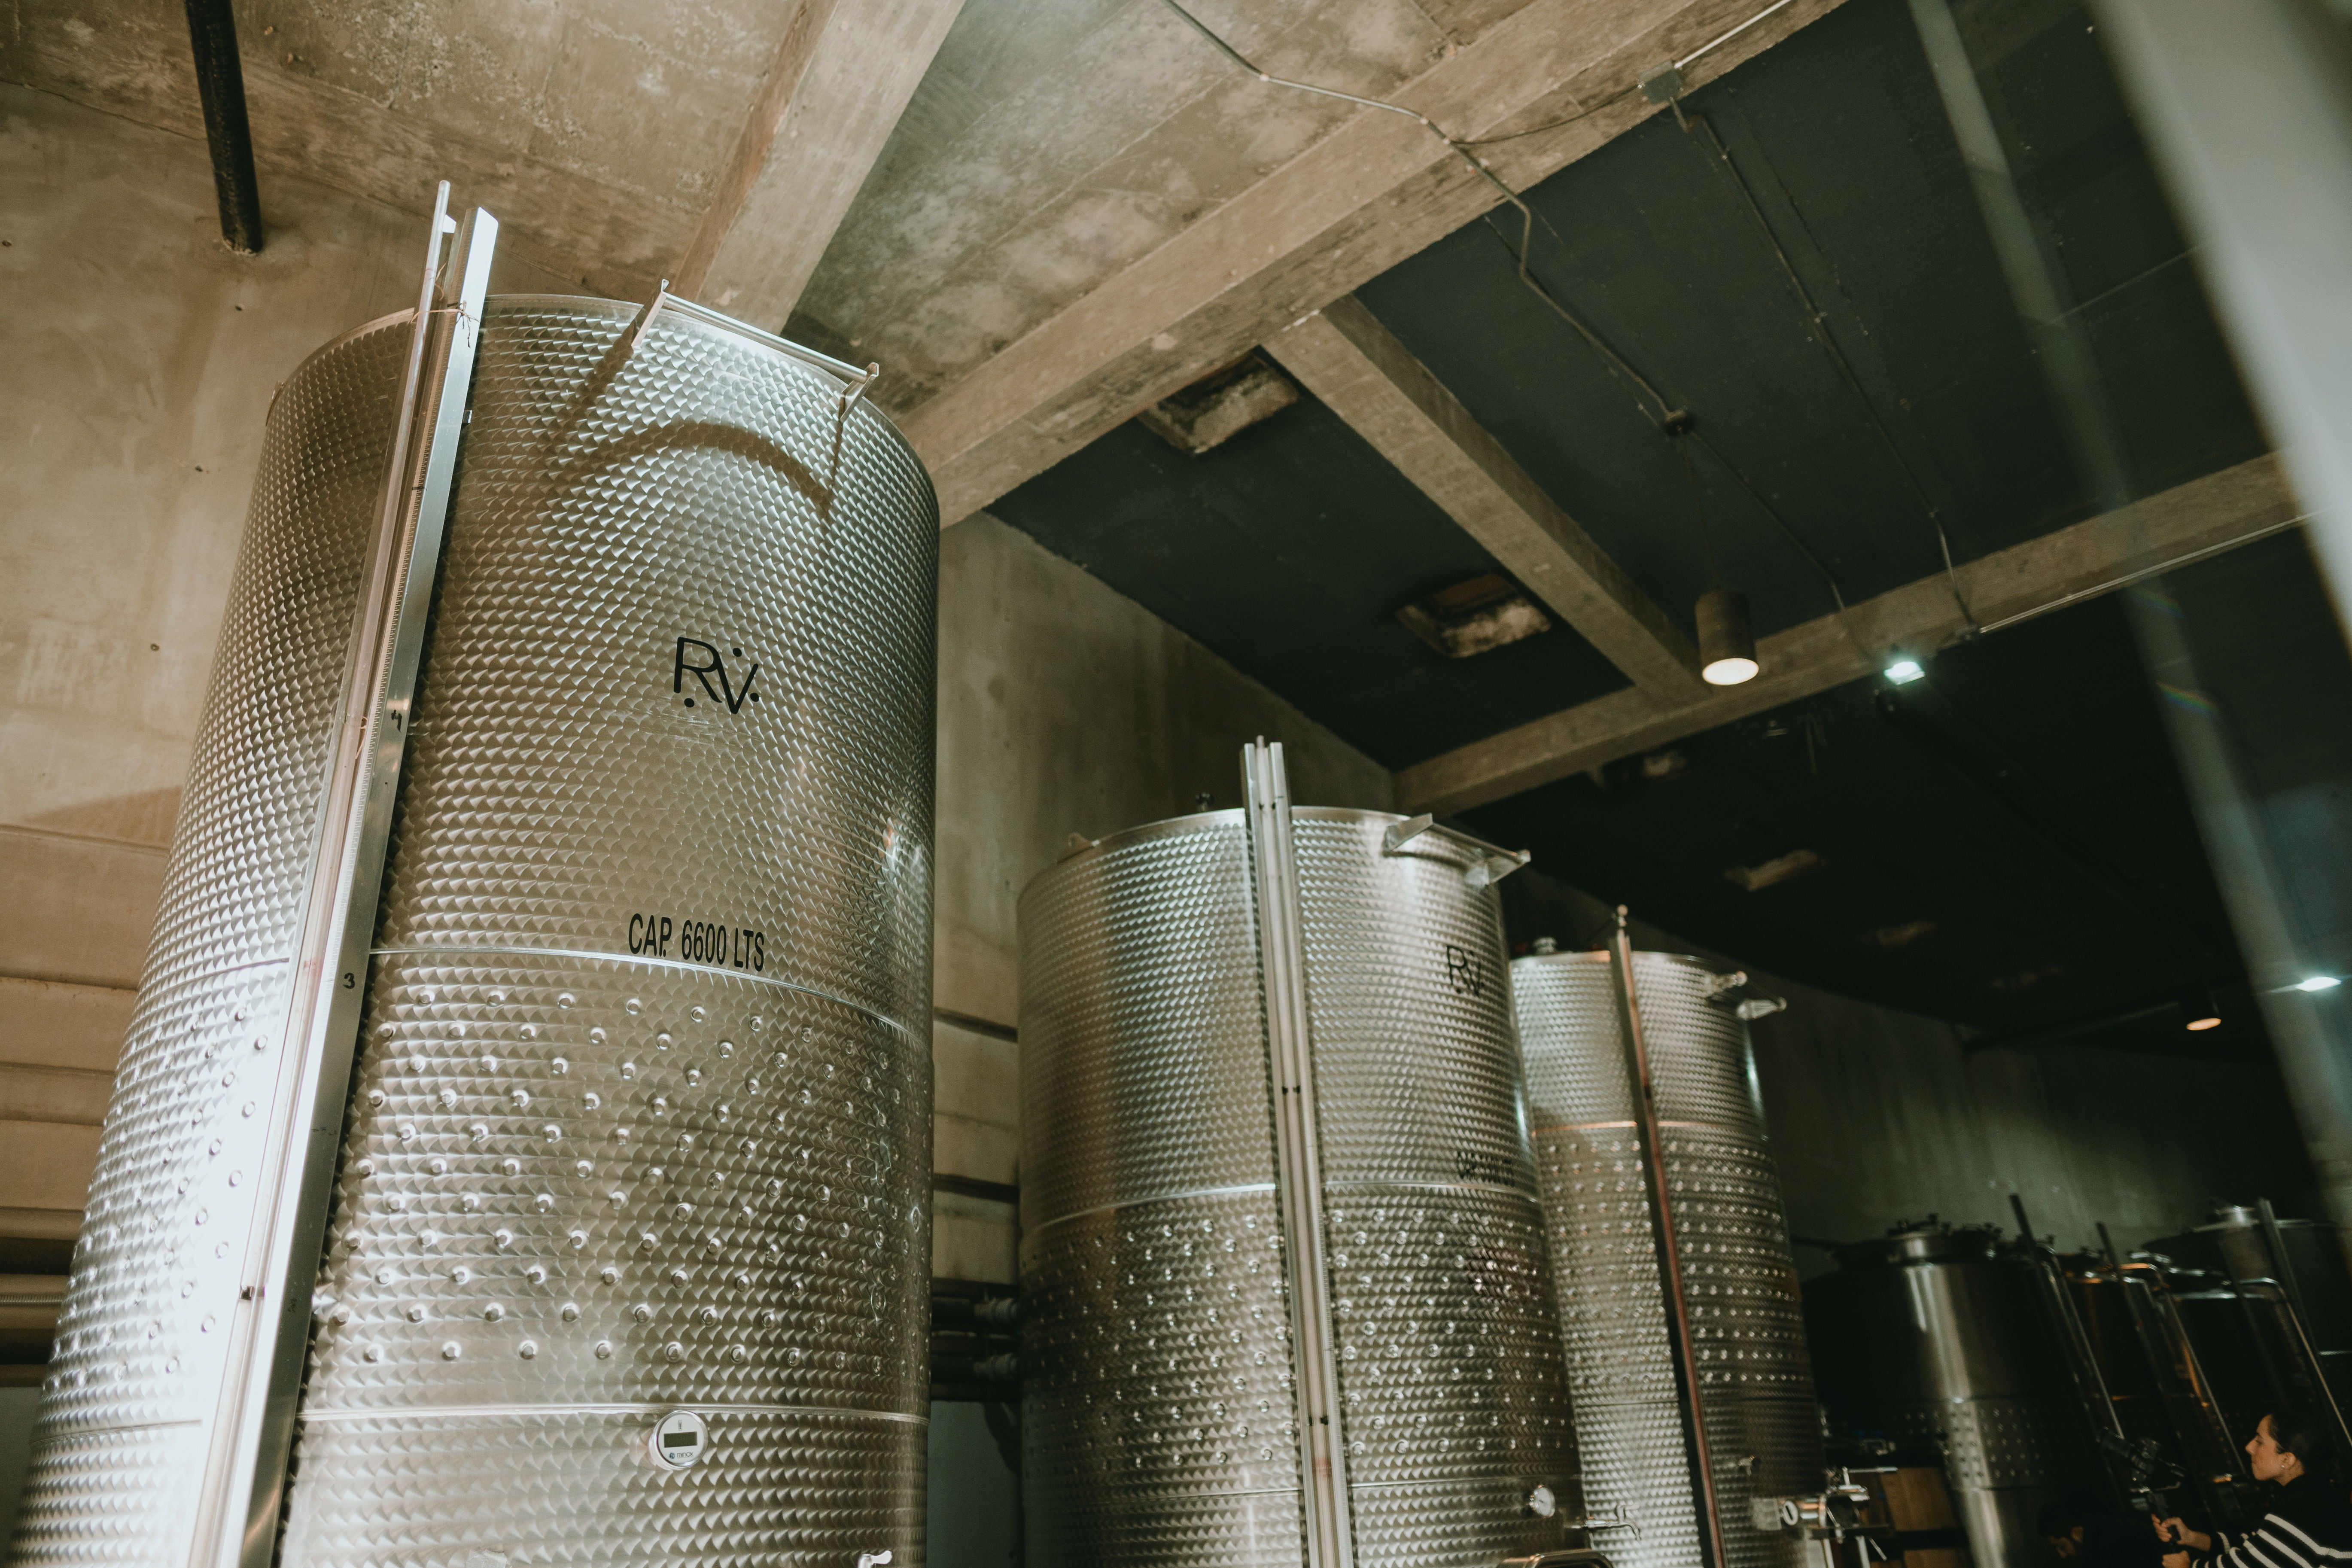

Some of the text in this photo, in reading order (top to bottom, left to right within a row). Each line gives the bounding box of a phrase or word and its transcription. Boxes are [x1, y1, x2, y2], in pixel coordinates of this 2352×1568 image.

[681, 919, 727, 965] 6600
[733, 927, 764, 972] LTS
[343, 972, 355, 989] 3
